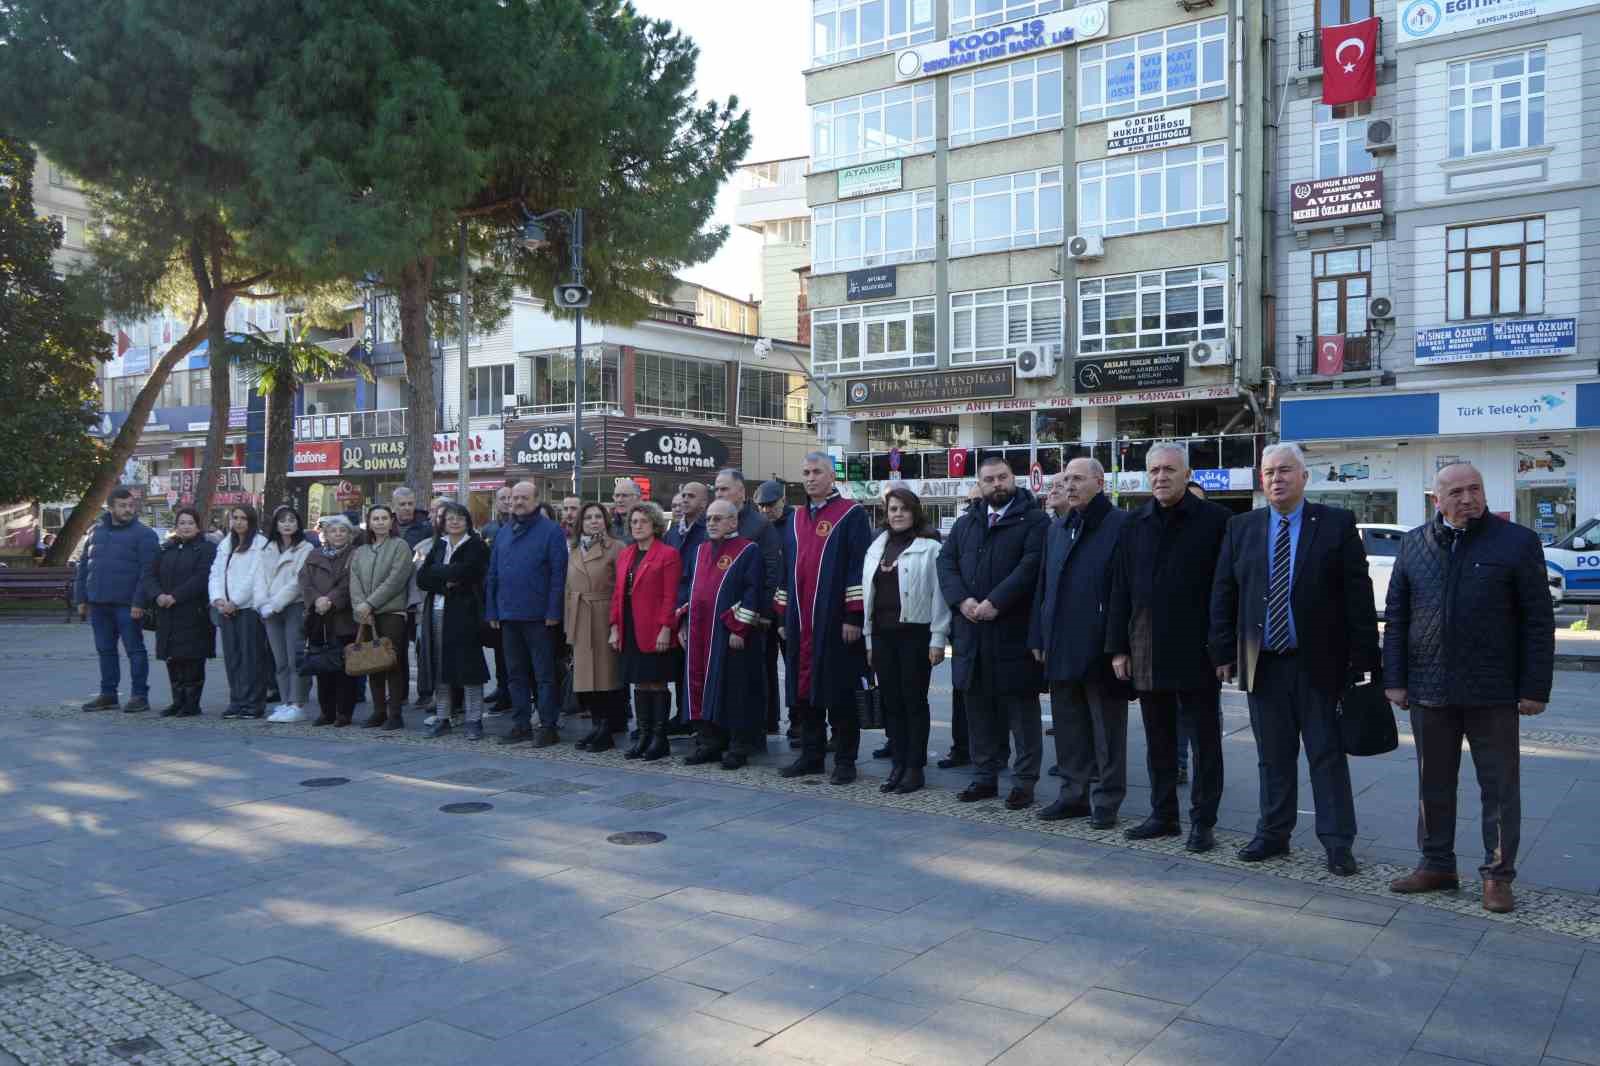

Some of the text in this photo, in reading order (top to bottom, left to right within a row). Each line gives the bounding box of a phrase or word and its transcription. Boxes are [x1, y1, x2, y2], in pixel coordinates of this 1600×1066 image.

[1476, 15, 1508, 25] SAMSUN
[1134, 113, 1166, 126] DENGE
[1113, 126, 1144, 138] HUKUK
[844, 161, 896, 178] ATAMER
[1313, 179, 1340, 190] HUKUK
[1306, 190, 1375, 207] AVUKAT
[1321, 203, 1349, 216] ÖZLEM
[1351, 199, 1382, 213] AKALIN
[1455, 327, 1487, 338] ÖZKURT
[1537, 320, 1573, 332] ÖZKURT
[871, 371, 1007, 394] TÜRK METAL SENDİKASI
[909, 404, 953, 416] KAHVALTI
[966, 399, 993, 411] ANIT
[996, 398, 1037, 410] TERME
[1088, 394, 1122, 405] KEBAP
[1137, 390, 1190, 401] KAHVALTI
[1207, 387, 1230, 397] 7/24
[1456, 403, 1541, 417] Türk Telekom
[528, 431, 572, 451] OBA
[658, 435, 702, 456] OBA
[369, 441, 405, 456] TIRAŞ
[294, 451, 328, 464] dafone
[363, 457, 408, 470] DÜNYAS
[517, 450, 584, 464] Restauran
[644, 451, 715, 468] Restaurant
[920, 481, 961, 497] ANIT
